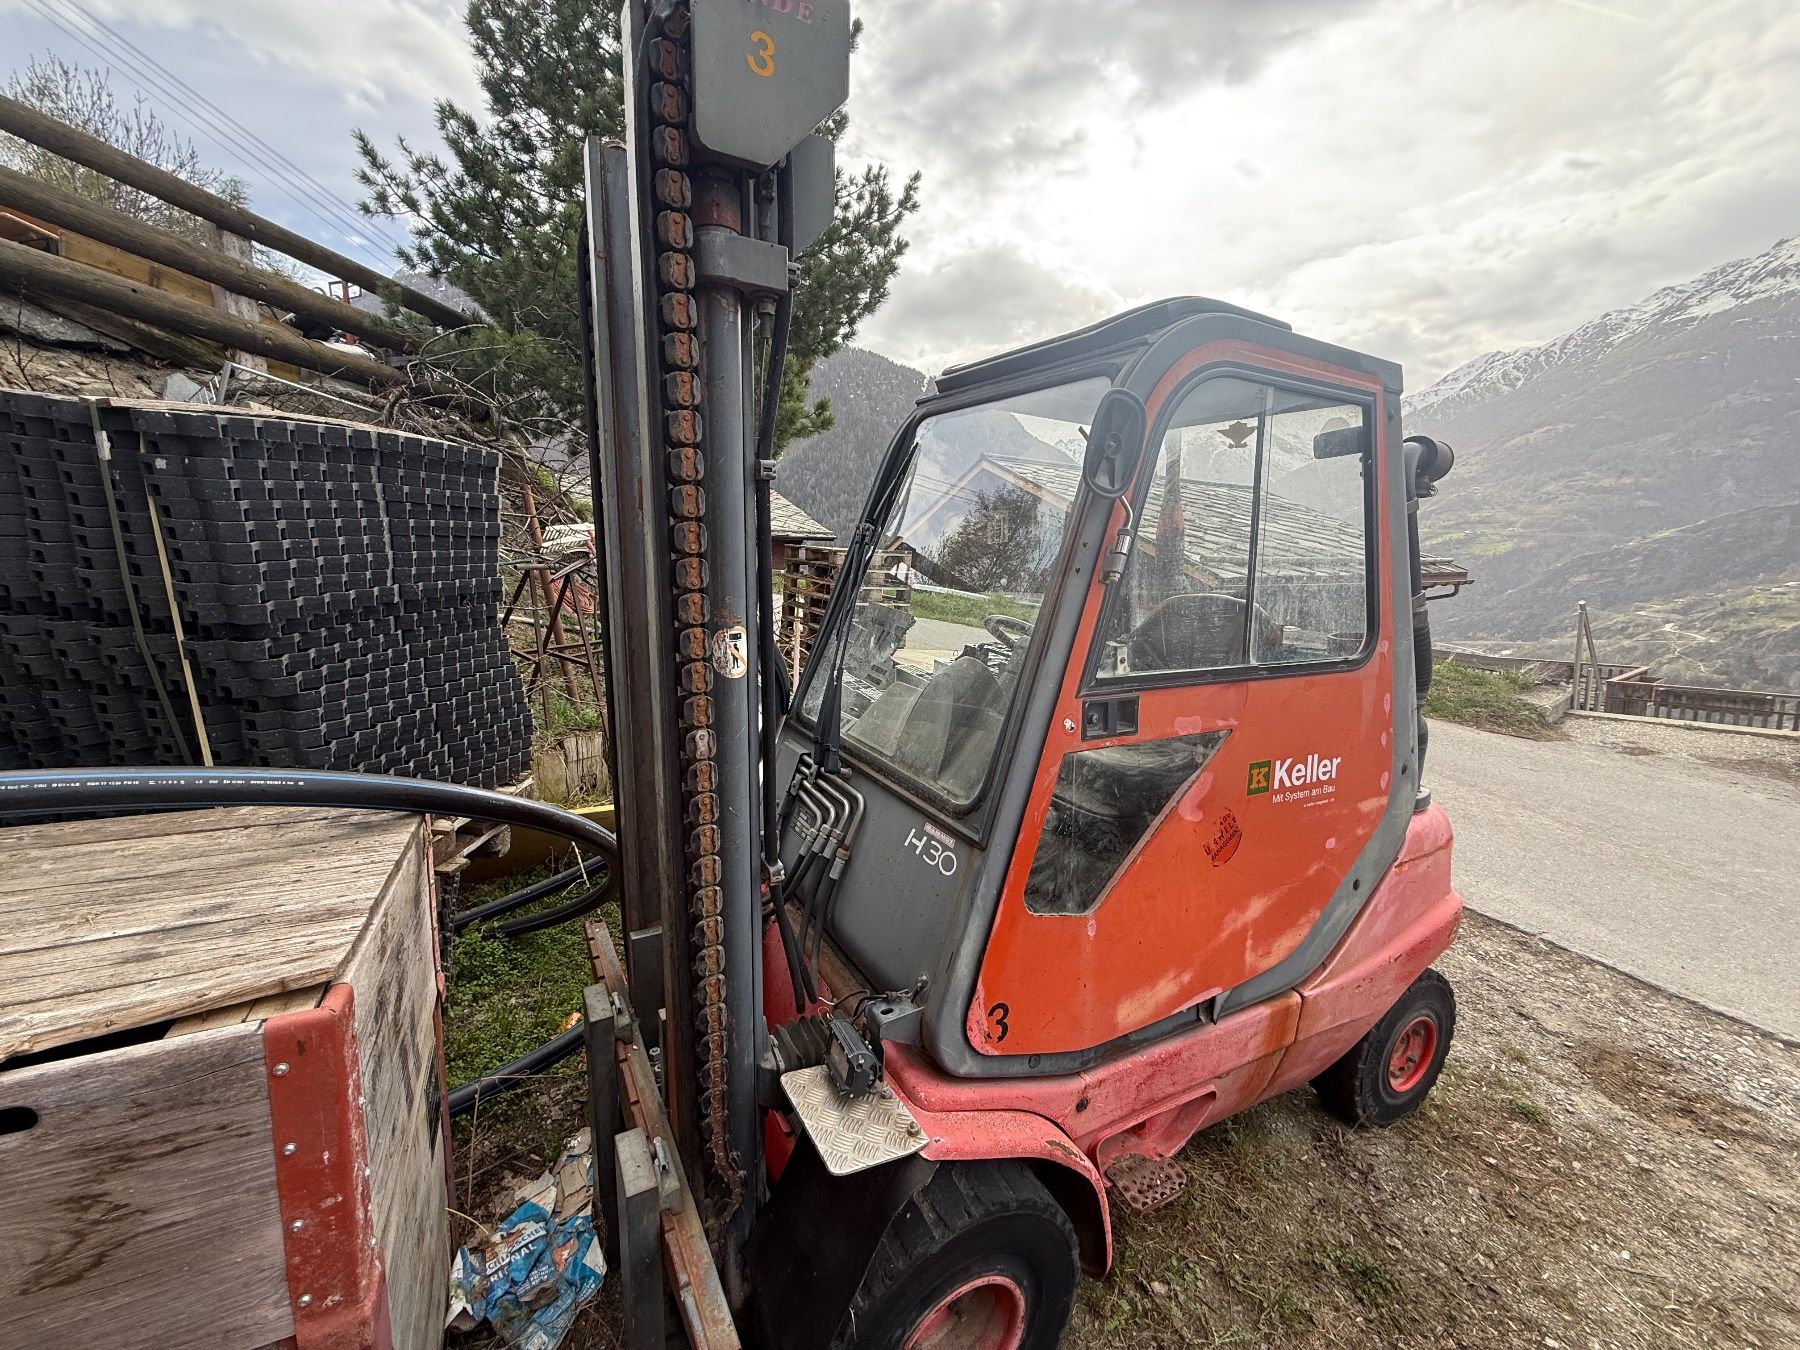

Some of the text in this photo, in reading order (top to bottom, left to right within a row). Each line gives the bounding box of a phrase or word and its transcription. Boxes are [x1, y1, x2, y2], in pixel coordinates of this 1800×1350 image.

[746, 31, 775, 77] 3
[1249, 753, 1342, 790] K Keller
[1272, 794, 1284, 804] Mit
[1284, 790, 1310, 803] System
[1311, 787, 1322, 797] am
[1323, 785, 1336, 794] Bau
[904, 828, 957, 876] H30
[986, 1002, 1009, 1043] 3
